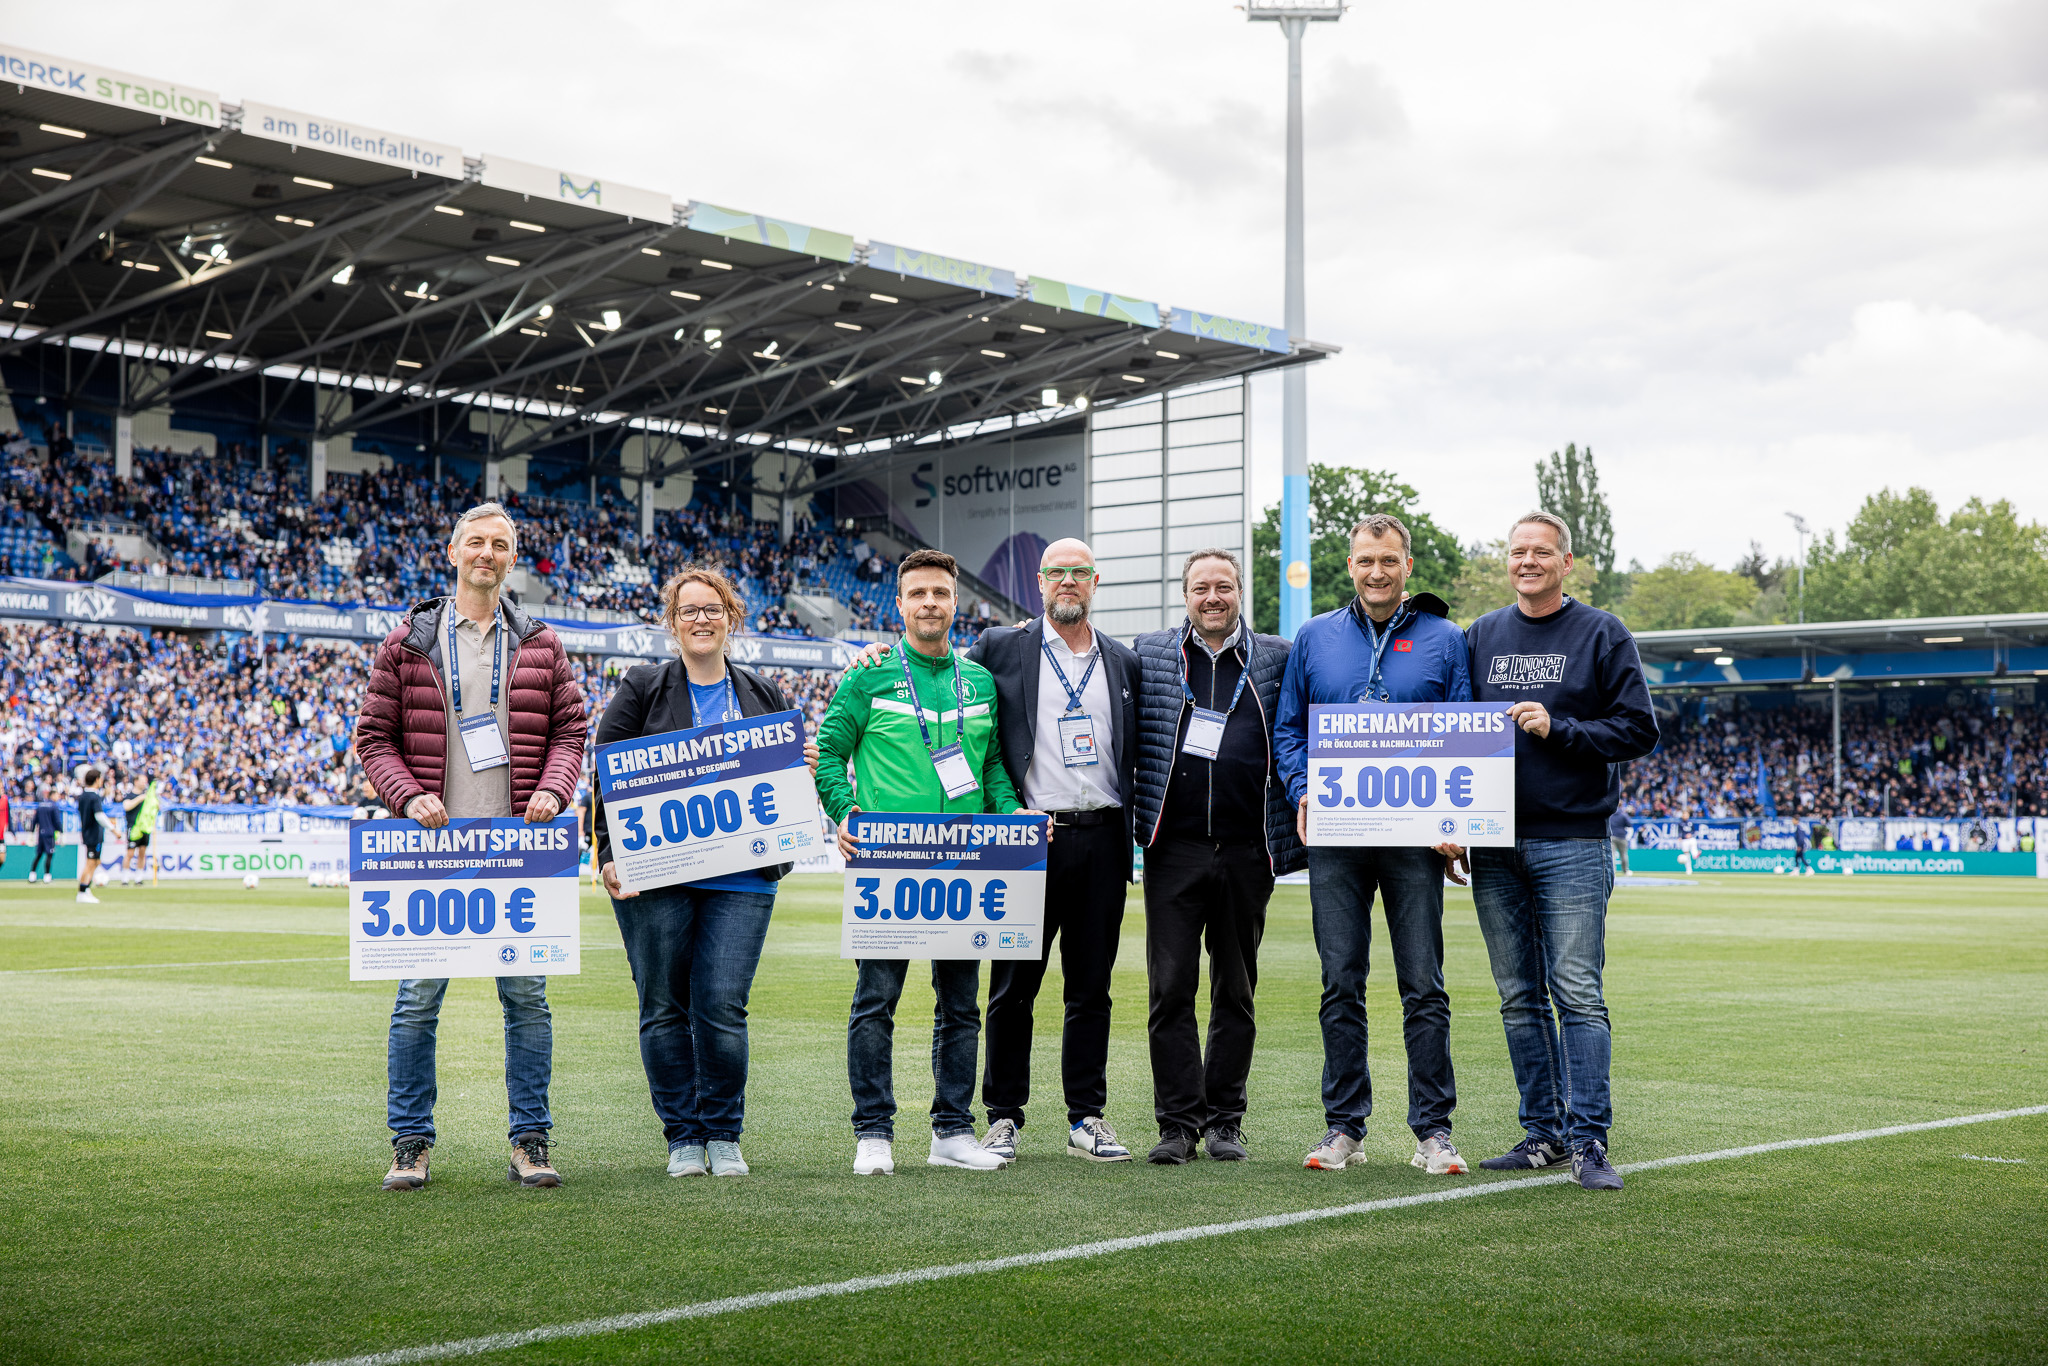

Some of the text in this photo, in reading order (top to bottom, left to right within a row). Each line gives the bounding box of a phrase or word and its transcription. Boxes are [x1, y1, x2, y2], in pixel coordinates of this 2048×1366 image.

[0, 55, 86, 92] ERCK
[263, 116, 445, 167] am Böllenfalltor
[945, 463, 1077, 496] software AG
[0, 592, 49, 610] KWEAR
[133, 602, 208, 620] WORKWEAR
[284, 612, 352, 629] WORKWEAR
[557, 631, 606, 647] ORKWEAR
[772, 646, 822, 660] WORKWEAR
[1545, 657, 1562, 666] FAIT
[1527, 665, 1560, 681] FORCE
[1319, 712, 1505, 733] EHRENAMTSPREIS
[607, 721, 796, 775] EHRENAMTSPREIS
[1319, 738, 1444, 748] FÜR ÖKOLOGIE & NACHHALTIGKEIT
[612, 760, 740, 791] FÜR GENERATIONEN & BEGEGNUNG
[1318, 765, 1474, 808] 3.000 €
[618, 782, 779, 851] 3.000 €
[361, 828, 569, 853] EHRENAMTSPREIS
[858, 822, 1039, 846] EHRENAMTSPREIS
[857, 849, 871, 858] FÜR
[873, 851, 935, 860] ZUSAMMENHALT
[946, 852, 980, 860] TEILHABE
[1730, 855, 1810, 869] bewerbe:
[1818, 854, 1963, 872] dr-wittmann.com
[310, 860, 330, 870] am
[361, 859, 523, 870] FÜR BILDUNG & WISSENSVERMITTLUNG
[854, 878, 1008, 921] 3.000 €
[362, 887, 536, 937] 3.000 €
